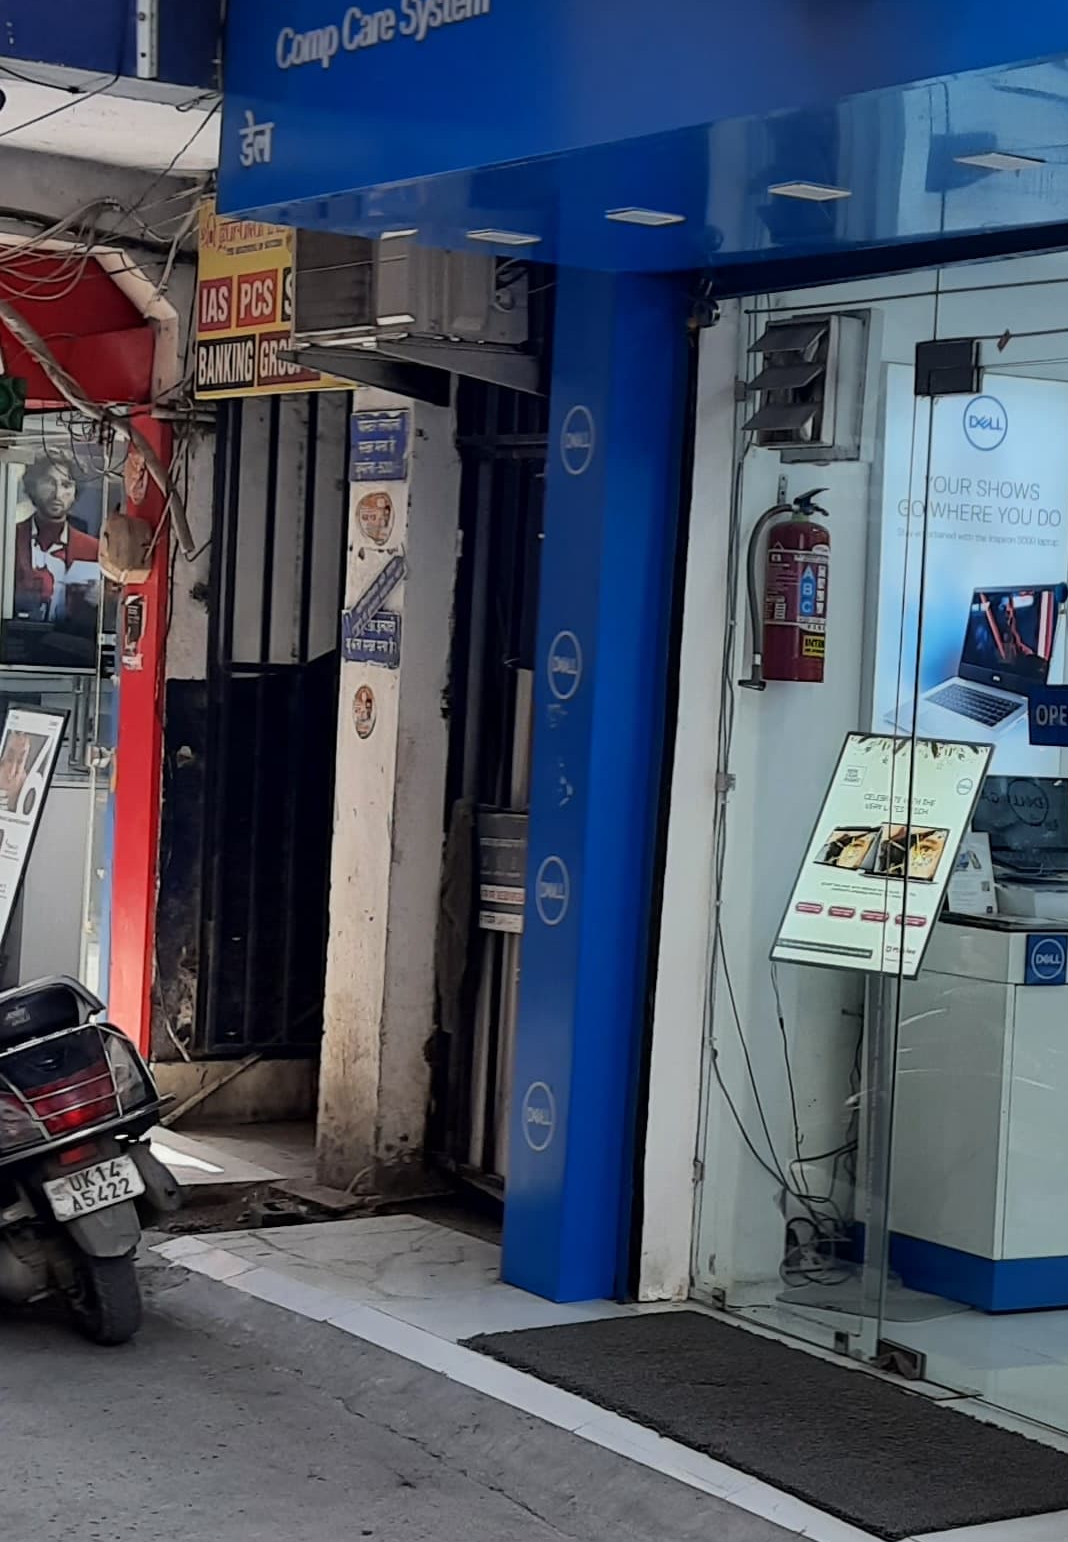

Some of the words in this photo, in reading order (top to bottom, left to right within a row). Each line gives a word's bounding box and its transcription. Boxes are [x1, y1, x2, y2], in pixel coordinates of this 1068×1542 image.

[276, 26, 339, 69] Comp
[342, 6, 395, 52] Care
[238, 109, 275, 167] डेल
[202, 285, 229, 324] IAS
[240, 279, 273, 319] PCS
[198, 340, 254, 386] BANKING
[969, 415, 1003, 431] DELL
[975, 479, 1041, 501] SHOWS
[897, 498, 927, 518] GO
[930, 501, 993, 523] WHERE
[998, 506, 1033, 526] YOU
[1037, 508, 1062, 528] DO
[1036, 953, 1061, 965] DELL
